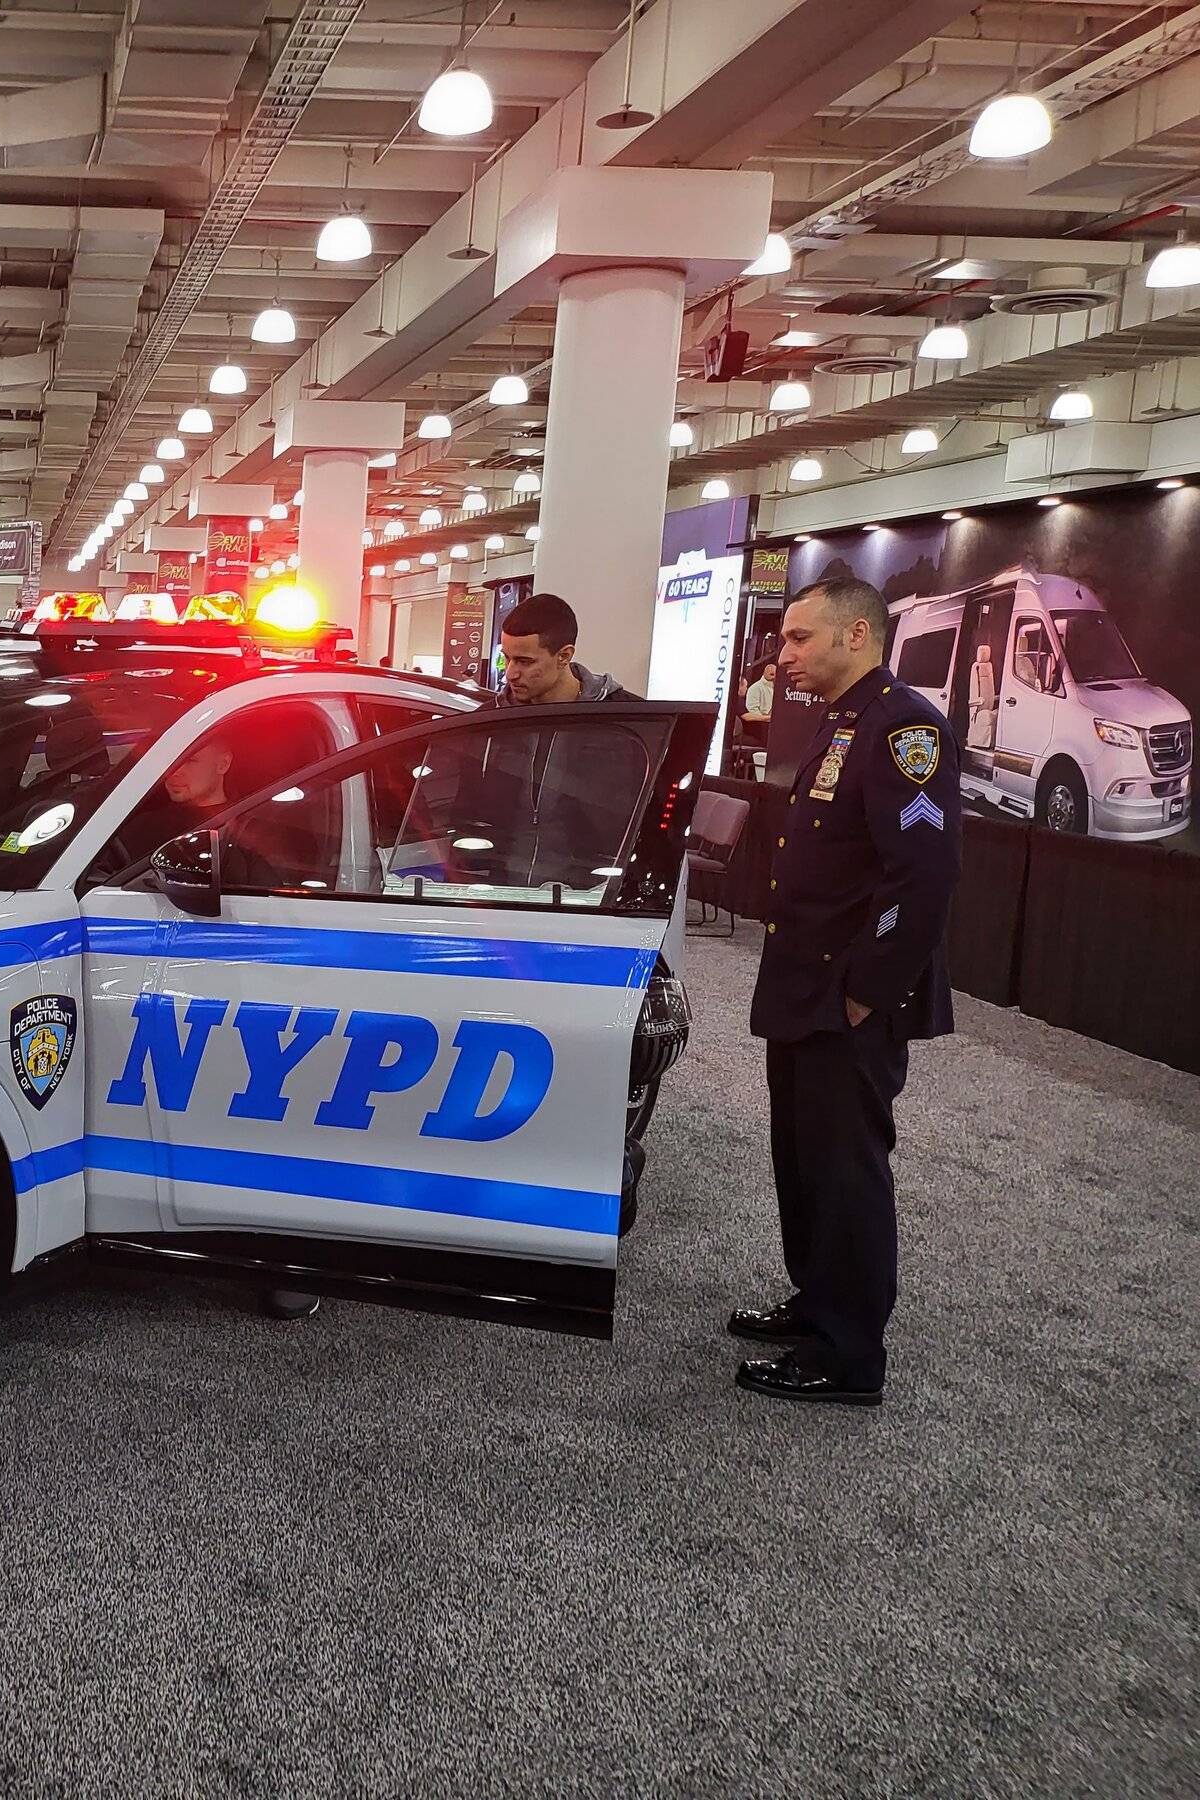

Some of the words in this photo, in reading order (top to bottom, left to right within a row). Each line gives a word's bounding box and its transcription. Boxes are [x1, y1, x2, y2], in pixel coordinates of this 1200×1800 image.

[763, 562, 787, 571] TRAC
[668, 581, 679, 597] 60
[680, 577, 710, 596] YEARS
[784, 686, 812, 707] Setting
[895, 736, 935, 748] DEPARTMENT
[901, 730, 926, 738] POLICE
[27, 998, 59, 1014] POLICE
[14, 1010, 73, 1037] DEPARTMENT
[13, 1048, 25, 1075] CITY
[20, 1078, 31, 1091] OF
[50, 1065, 64, 1090] NEW
[61, 1033, 74, 1061] YORK
[106, 993, 554, 1142] NYPD
